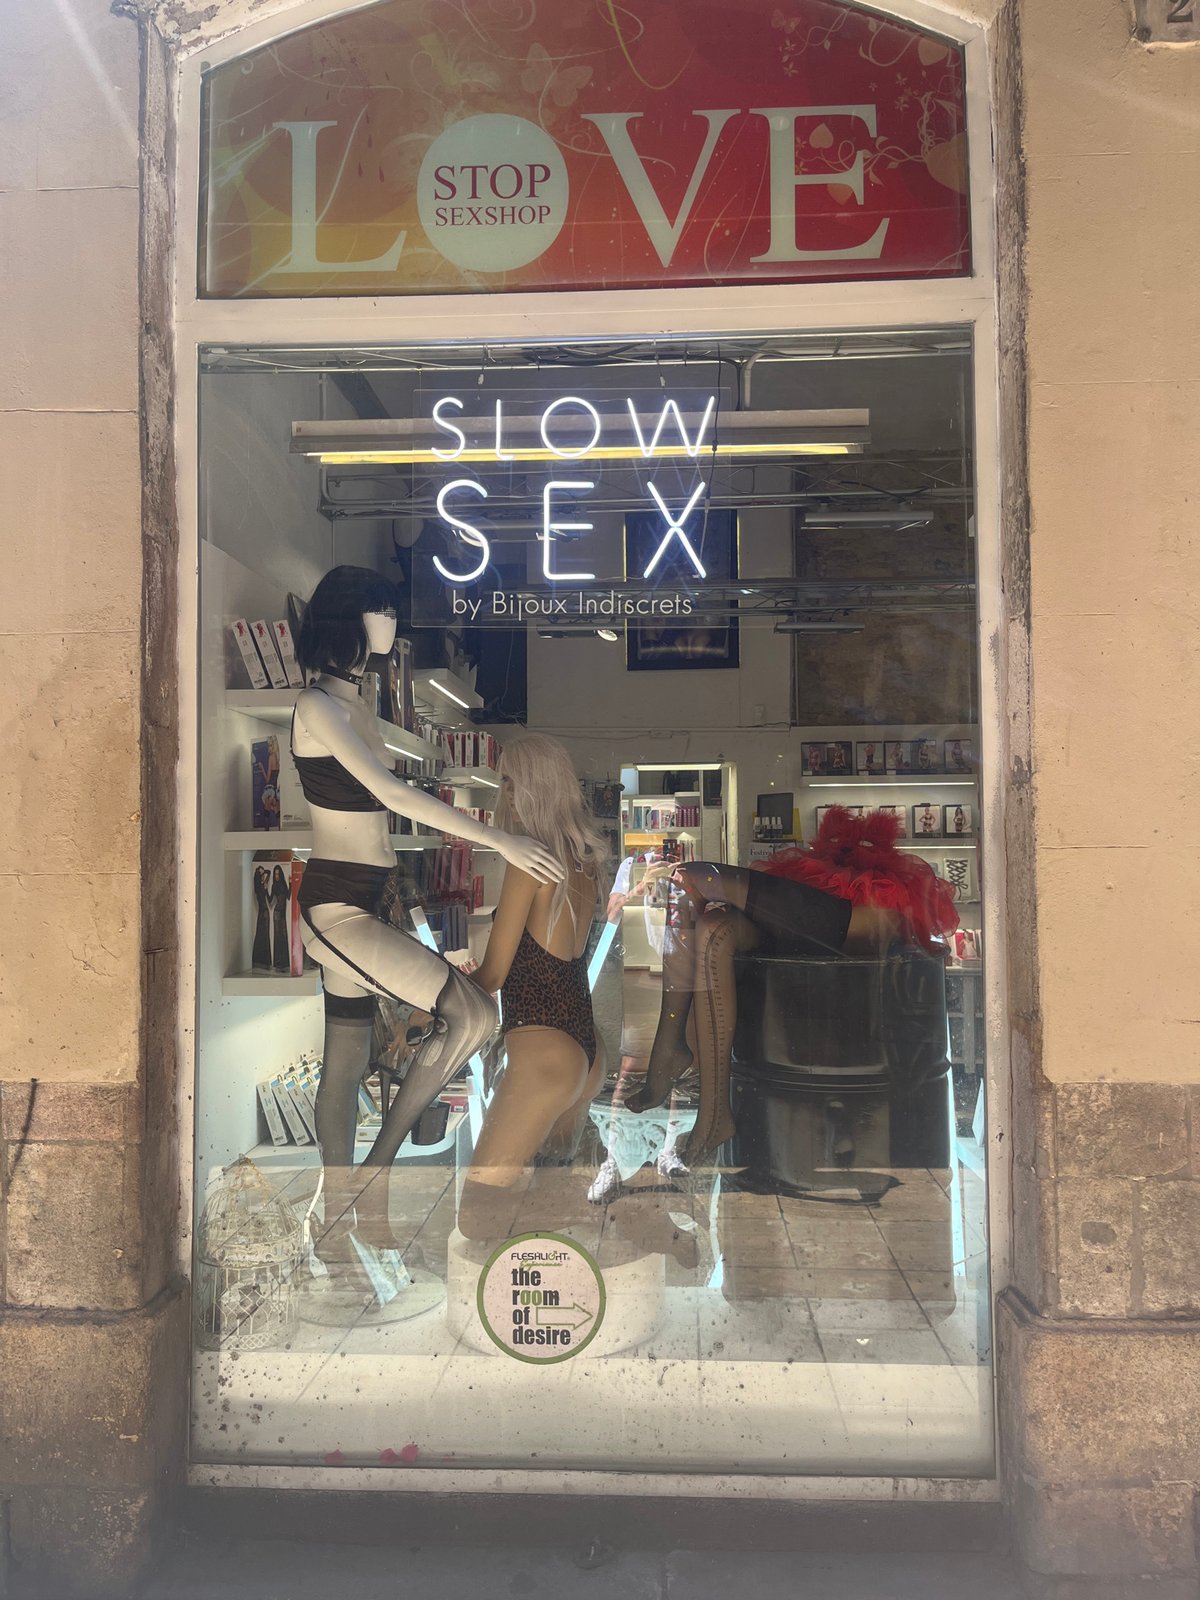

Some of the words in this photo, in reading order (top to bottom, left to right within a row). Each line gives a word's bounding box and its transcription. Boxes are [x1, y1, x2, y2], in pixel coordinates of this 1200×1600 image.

[271, 104, 890, 273] LOVE
[433, 163, 551, 201] STOP
[434, 205, 551, 227] SEXSHOP
[430, 395, 716, 460] SLOW
[431, 478, 708, 583] SEX
[452, 589, 482, 621] by
[492, 590, 568, 621] Bijoux
[578, 589, 693, 615] Indiscrets
[511, 1267, 542, 1287] the
[511, 1289, 560, 1306] room
[512, 1306, 531, 1325] of
[512, 1325, 571, 1346] desire
